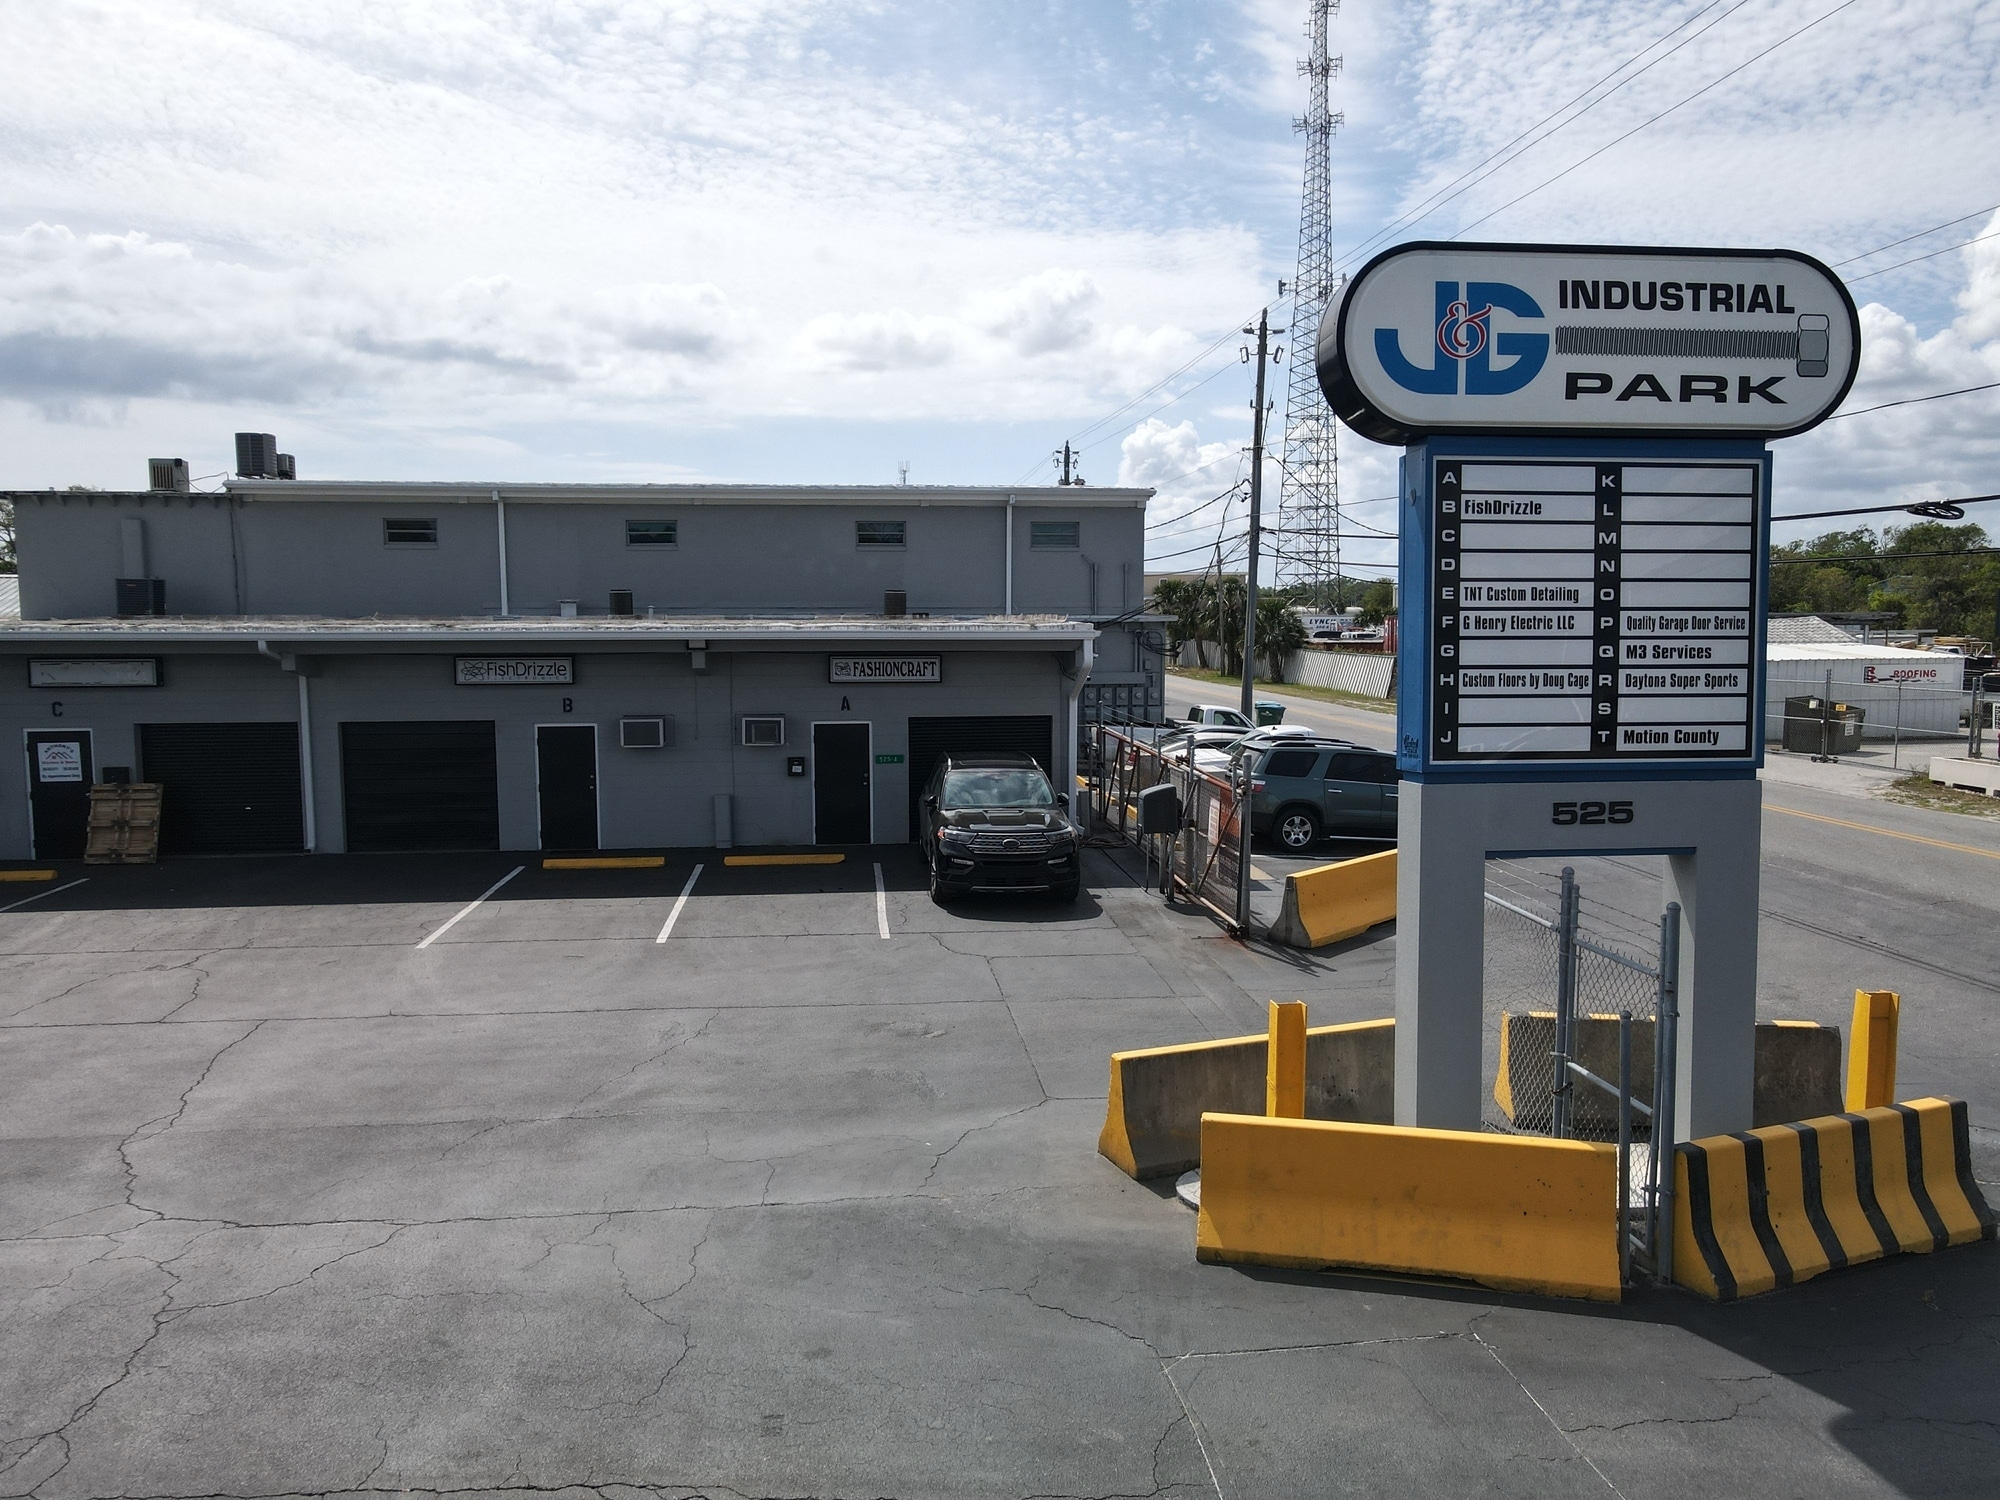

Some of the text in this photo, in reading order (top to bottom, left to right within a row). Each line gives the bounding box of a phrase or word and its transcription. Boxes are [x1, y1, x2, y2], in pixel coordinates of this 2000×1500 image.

[1558, 279, 1796, 315] INDUSTRIAL
[1564, 371, 1788, 405] PARK
[1441, 471, 1457, 484] A
[1601, 475, 1615, 488] K
[1441, 499, 1542, 516] B FishDrizzle
[1603, 503, 1614, 516] L
[1441, 529, 1456, 542] C
[1598, 532, 1617, 545] M
[1441, 558, 1456, 571] D
[1600, 560, 1615, 573] N
[1442, 586, 1579, 604] E TNT Custom Detailing
[1600, 588, 1615, 601] O
[1442, 615, 1575, 633] F G Henry Electric LLC
[1600, 615, 1746, 633] P Quality Garage Door Service
[1440, 644, 1455, 657] G
[1599, 644, 1712, 660] Q M3 Services
[486, 661, 567, 677] FishDrizzle
[852, 661, 937, 677] FASHIONCRAFT
[1893, 669, 1937, 678] ROOFING
[1440, 672, 1590, 690] H Custom Floors by Doug Cage
[1598, 672, 1739, 690] R Daytona Super Sports
[51, 701, 63, 717] C
[562, 697, 574, 713] B
[840, 695, 851, 711] A
[1444, 702, 1449, 715] I
[1597, 702, 1611, 715] S
[1440, 730, 1452, 743] J
[1597, 729, 1720, 746] T Motion County
[1551, 800, 1634, 826] 525
